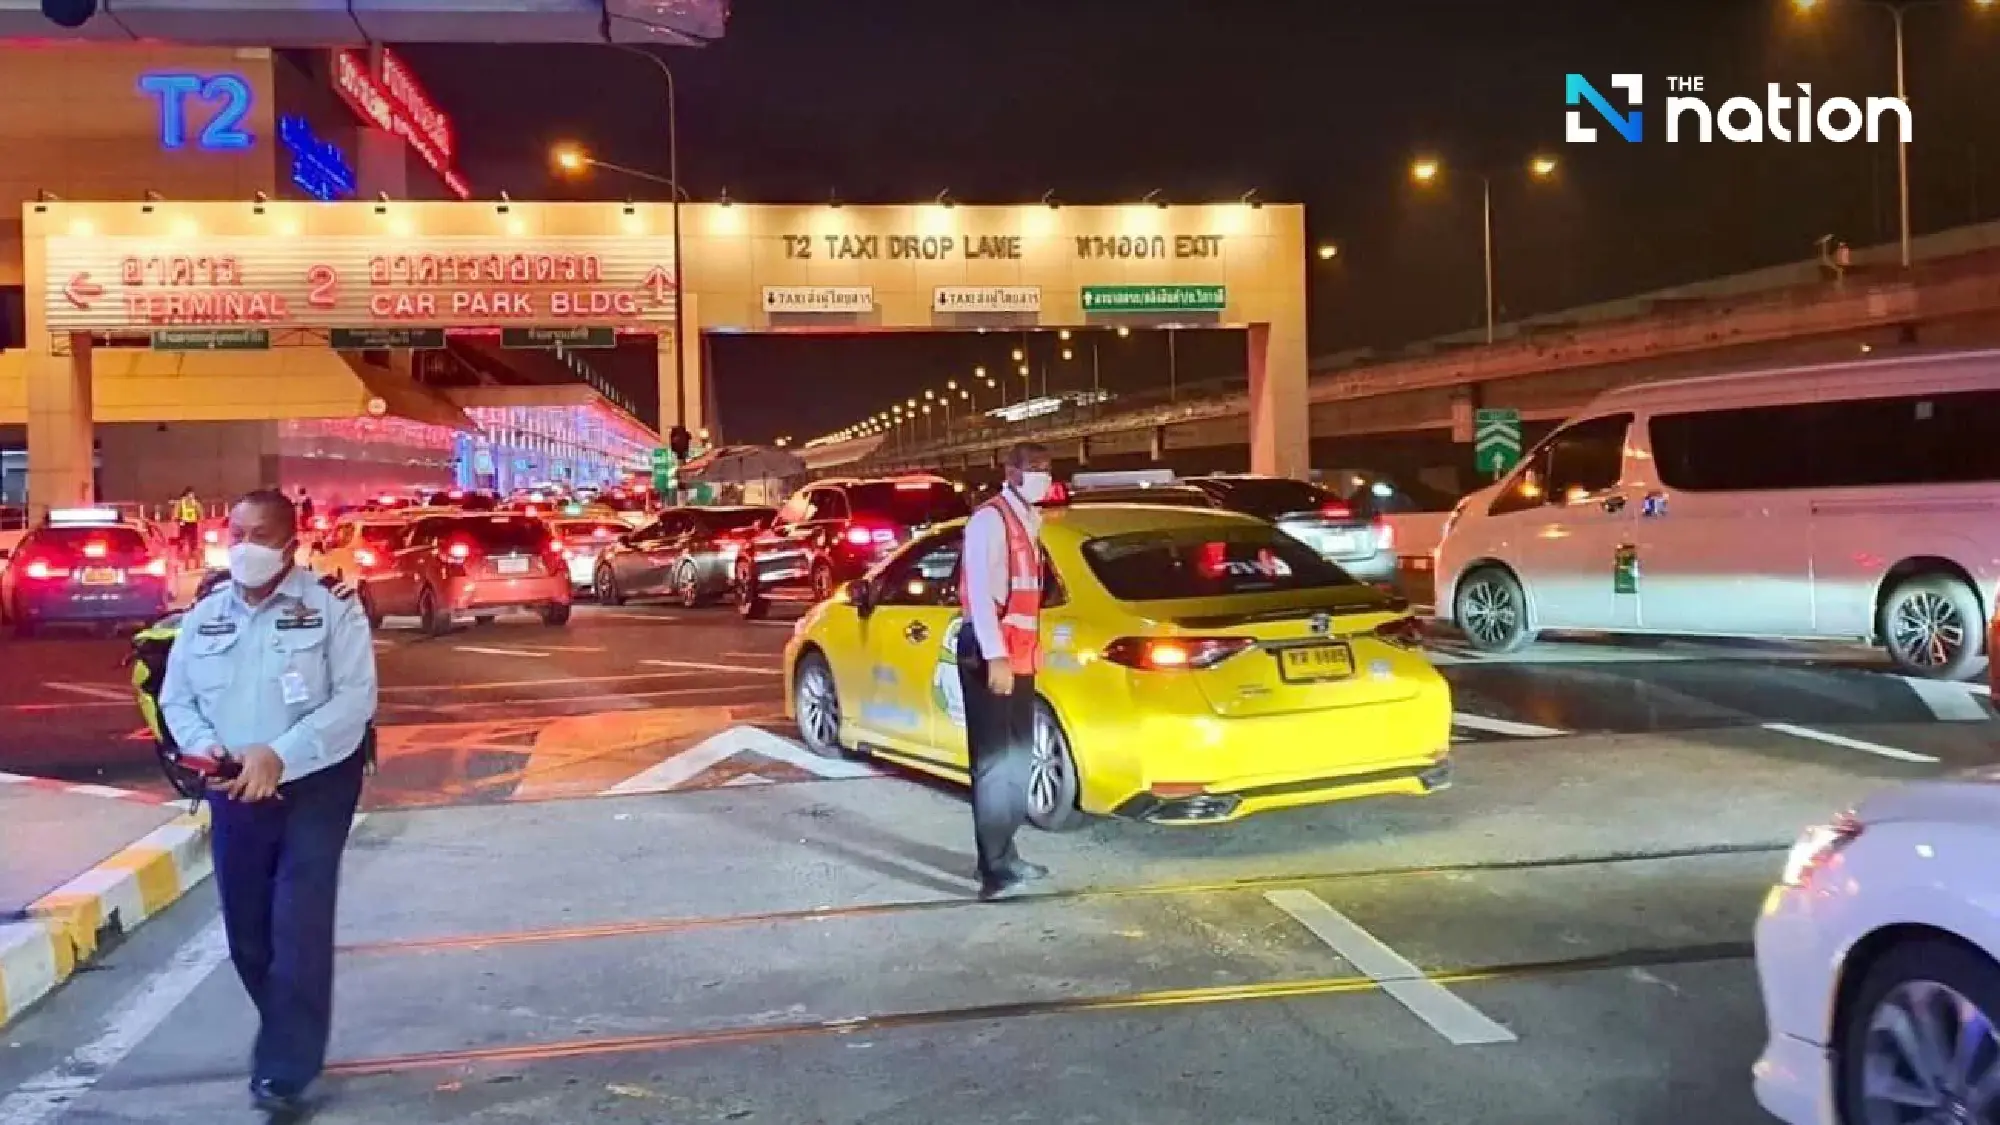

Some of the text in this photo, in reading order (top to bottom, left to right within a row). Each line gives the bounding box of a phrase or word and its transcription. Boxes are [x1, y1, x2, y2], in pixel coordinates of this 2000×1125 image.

[139, 75, 252, 147] T2
[783, 235, 812, 259] T2
[825, 235, 879, 259] TAXI
[888, 235, 954, 259] DROP
[1076, 235, 1223, 259] ทางออก EXIT
[121, 257, 242, 286] อาคาร
[369, 254, 602, 285] อาคารจอดรถ
[307, 264, 338, 308] 2
[124, 293, 285, 321] TERMINAL
[370, 291, 437, 316] CAR
[451, 291, 534, 316] PARK
